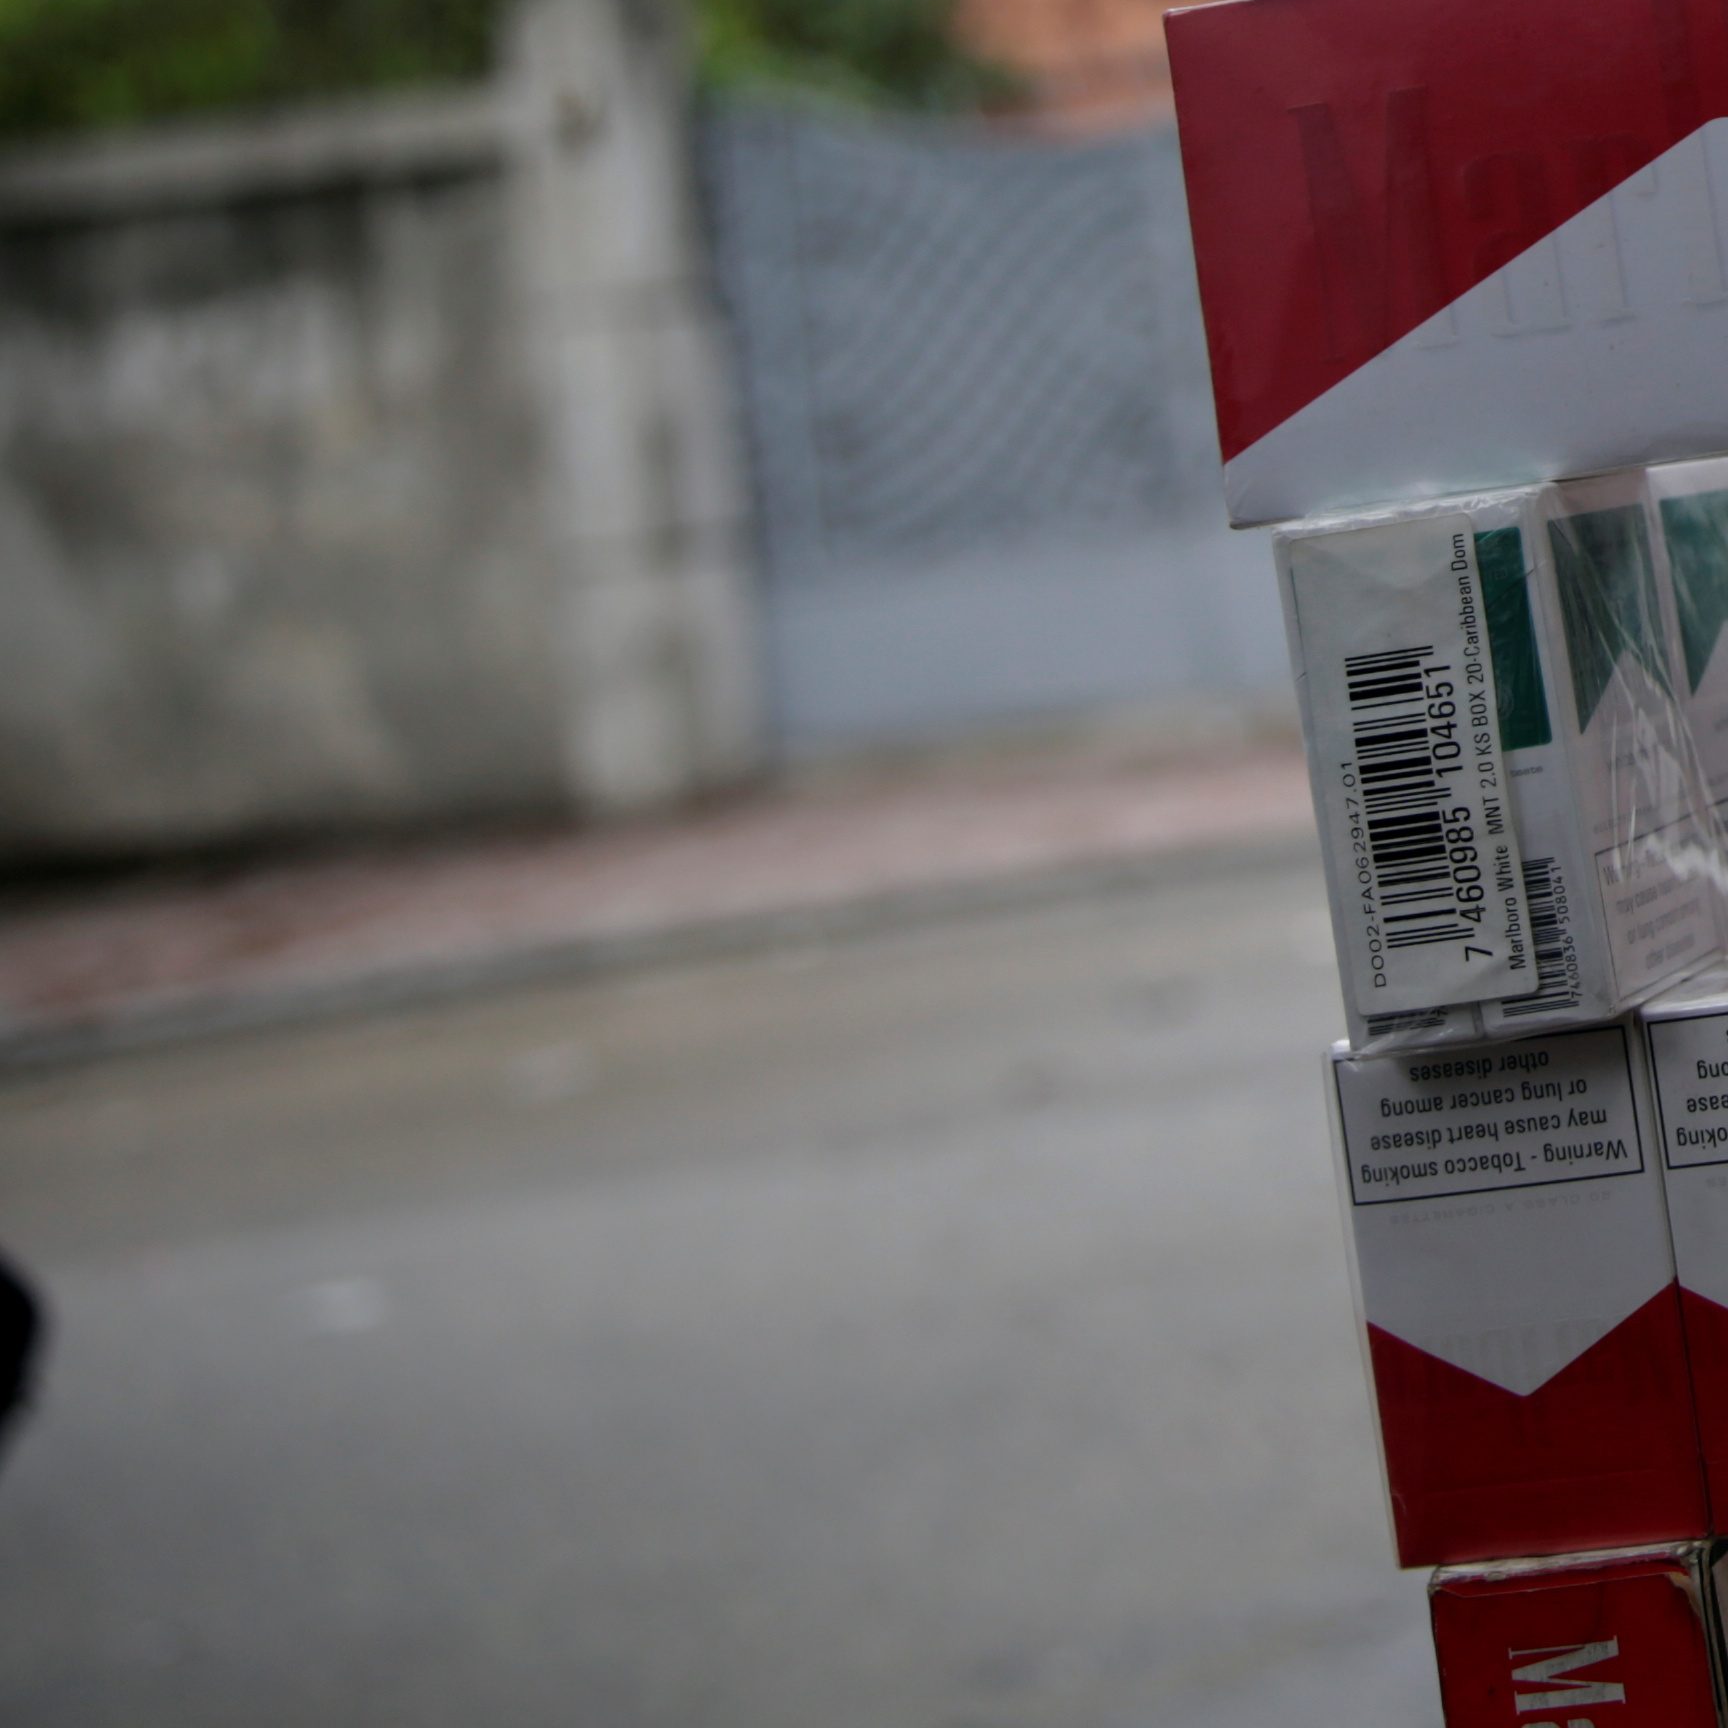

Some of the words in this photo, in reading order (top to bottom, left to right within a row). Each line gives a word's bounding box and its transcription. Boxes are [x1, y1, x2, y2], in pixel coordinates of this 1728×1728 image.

[1451, 533, 1468, 572] Dom
[1424, 665, 1463, 778] 104651
[1468, 691, 1489, 728] BOX
[1473, 732, 1492, 757] KS
[1479, 761, 1498, 790] 2.0
[1483, 797, 1505, 835] MNT
[1442, 806, 1485, 924] 460985
[1495, 845, 1513, 893] White
[1503, 896, 1527, 971] Marlboro
[1409, 1056, 1494, 1081] diseases
[1498, 1049, 1551, 1073] other
[1450, 1085, 1517, 1109] cancer
[1521, 1079, 1564, 1102] lung
[1567, 1077, 1588, 1095] or
[1381, 1093, 1446, 1116] among
[1503, 1113, 1562, 1136] cause
[1567, 1107, 1608, 1128] may
[1369, 1128, 1443, 1152] disease
[1446, 1121, 1500, 1145] heart
[1443, 1151, 1527, 1175] Tobacco
[1542, 1138, 1629, 1166] Warning
[1360, 1160, 1439, 1187] smoking
